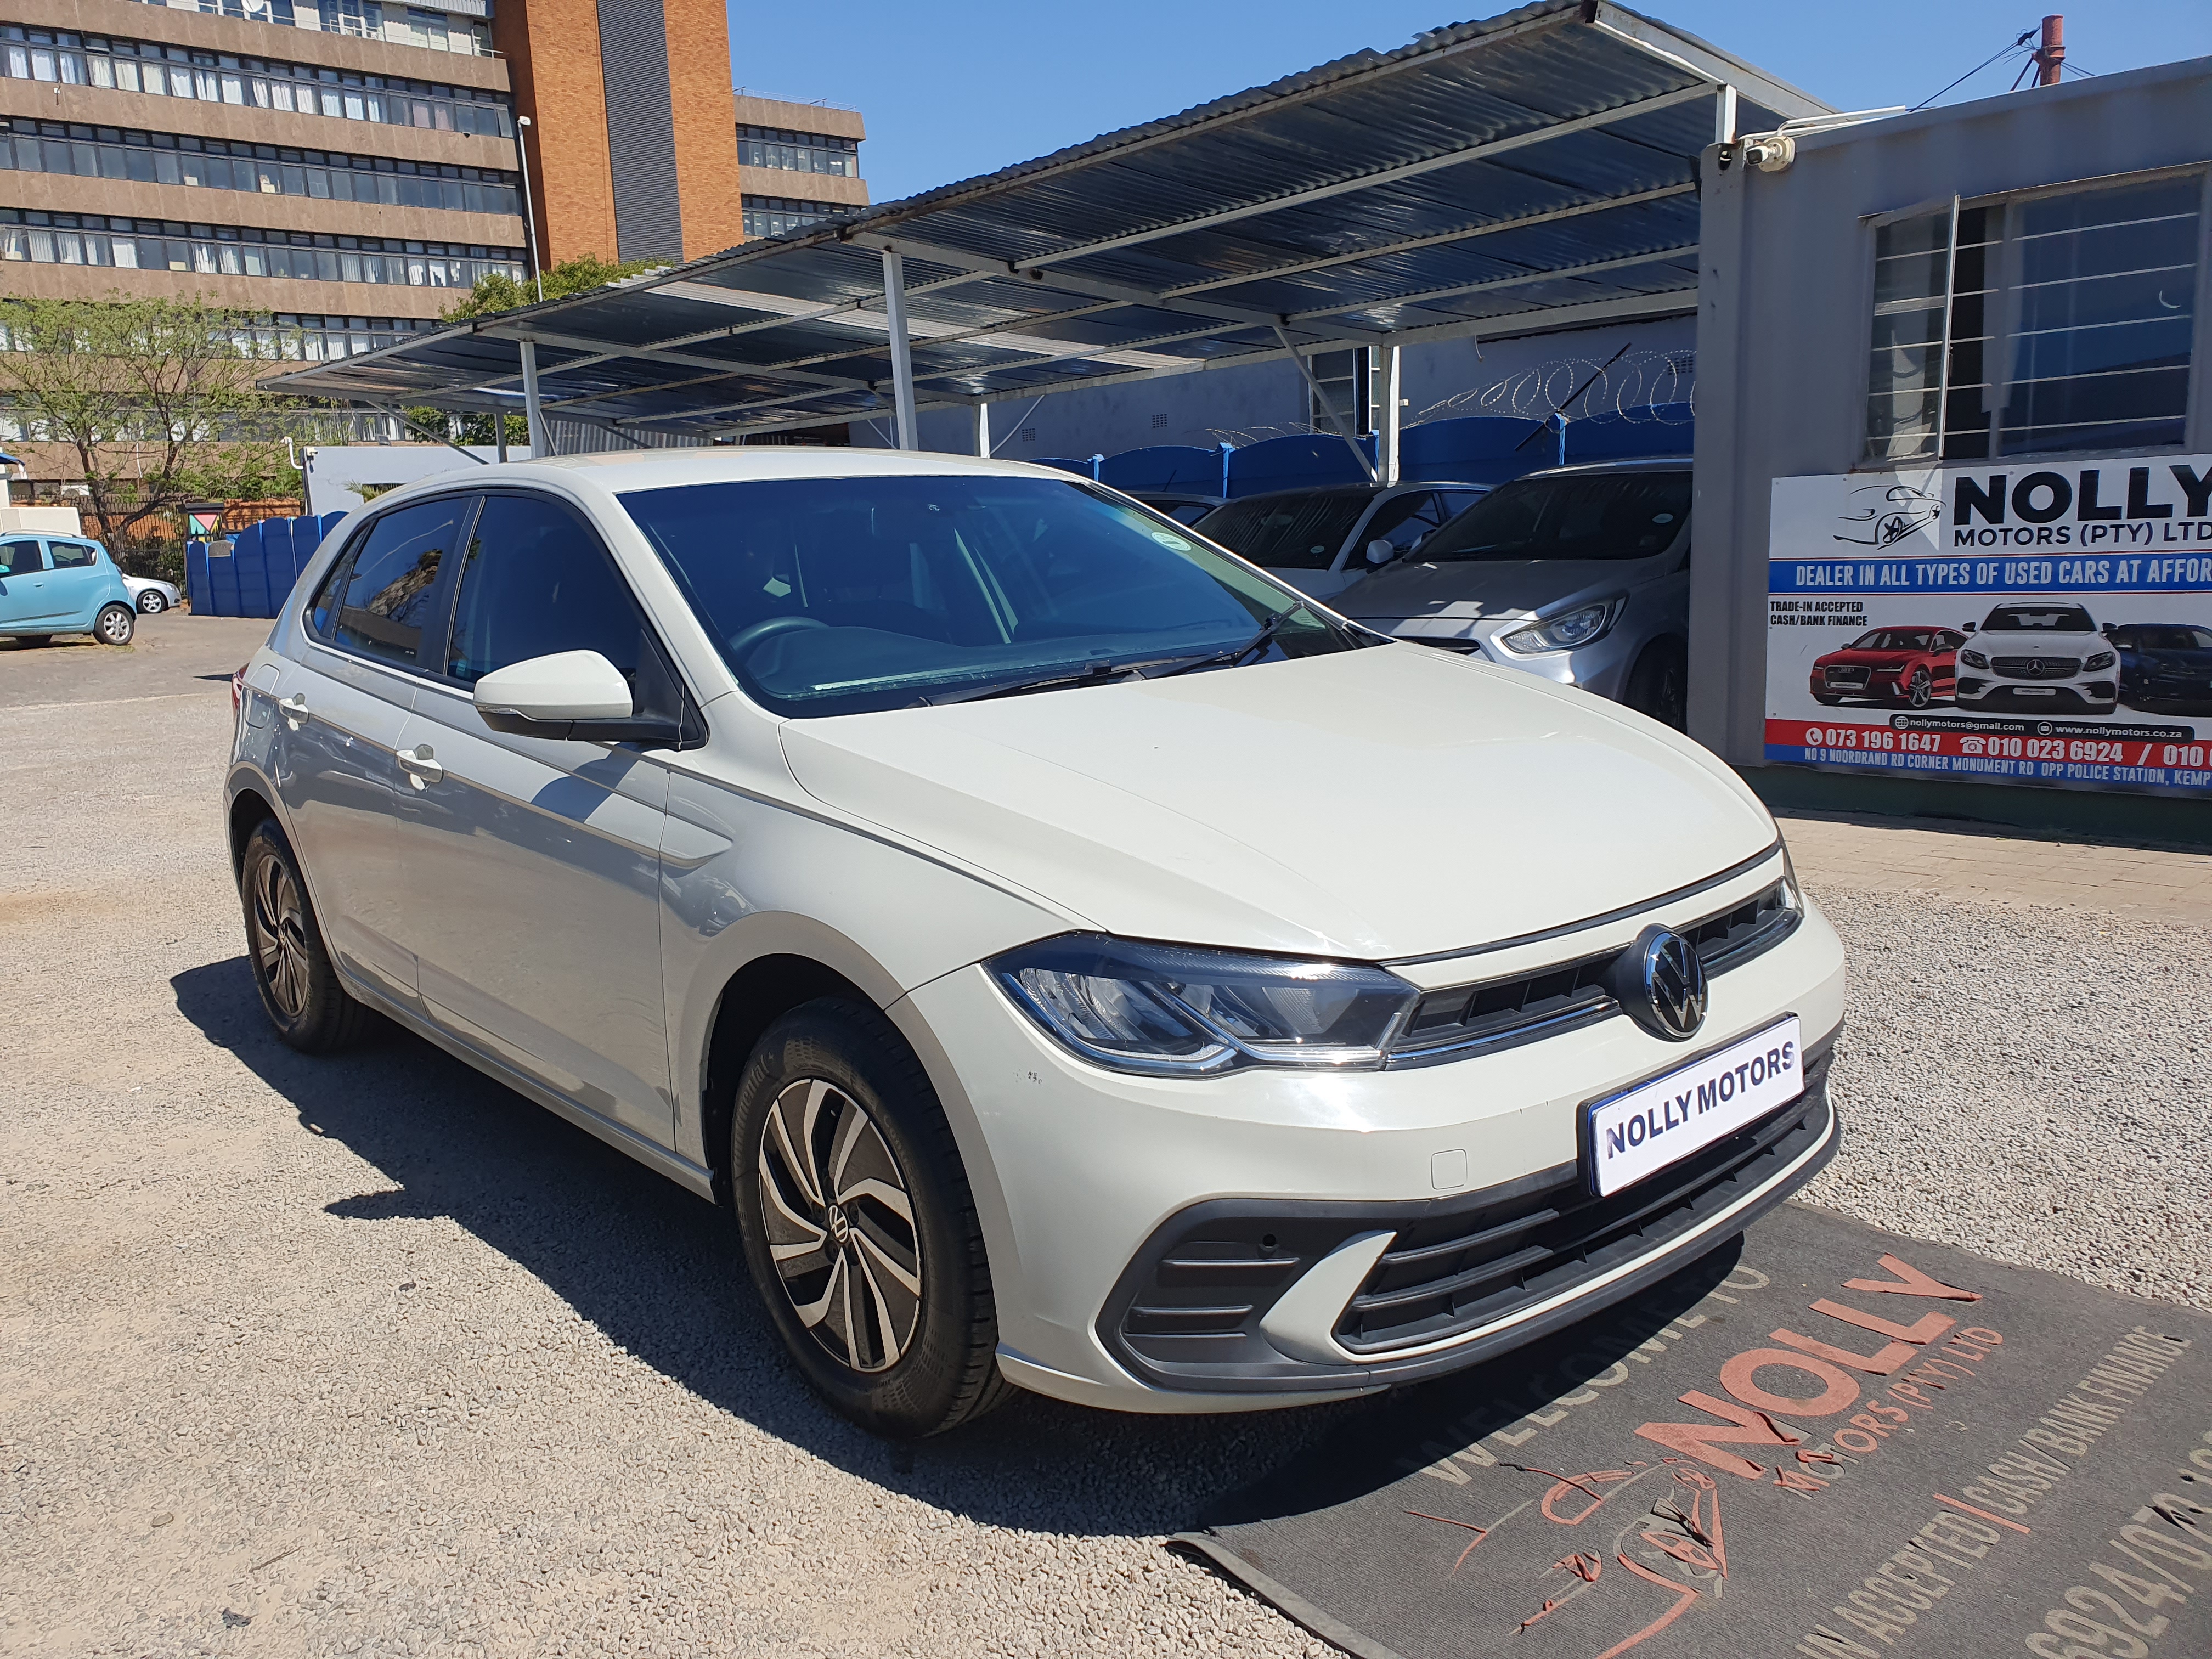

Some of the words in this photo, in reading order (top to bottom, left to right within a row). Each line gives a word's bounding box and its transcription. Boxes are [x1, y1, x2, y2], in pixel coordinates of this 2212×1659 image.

[1953, 464, 2212, 526] NOLLY
[1954, 525, 2071, 547] MOTORS
[2080, 521, 2153, 547] (PTY)
[2163, 521, 2212, 541] LTD
[1796, 565, 1853, 586] DEALER
[1859, 565, 1875, 585] IN
[1880, 564, 1910, 585] ALL
[1915, 562, 1970, 585] TYPES
[1976, 562, 1999, 585] OF
[2004, 561, 2052, 584] USED
[2058, 560, 2110, 584] CARS
[2115, 559, 2141, 583] AT
[1770, 601, 1812, 612] TRADE-IN
[1814, 601, 1863, 612] ACCEPTED
[1770, 614, 1826, 626] CASH/BANK
[1827, 615, 1867, 626] FINANCE
[1826, 728, 1857, 747] 073
[1861, 731, 1893, 749] 196
[1898, 733, 1941, 752] 1647
[1910, 718, 2024, 732] nollymotors@gmail.com
[2055, 726, 2182, 738] www.nollymotors.co.za
[1804, 748, 1818, 760] NO
[1820, 748, 1826, 761] 9
[1830, 749, 1888, 766] NOORDRAND
[1891, 753, 1904, 767] RD
[1908, 754, 1948, 770] CORNER
[1952, 757, 2016, 774] MONUMENT
[2018, 760, 2034, 775] RD
[2041, 762, 2063, 777] OPP
[2067, 763, 2109, 780] POLICE
[2113, 766, 2170, 786] STATION,
[1988, 736, 2022, 757] 010
[2026, 738, 2065, 759] 023
[2069, 742, 2123, 762] 6924
[2163, 744, 2204, 767] 010
[1606, 1088, 1692, 1159] NOLLY
[1697, 1041, 1795, 1115] MOTORS
[1397, 1299, 1708, 1486] WELCOME
[1673, 1263, 1771, 1305] TO
[1633, 1251, 1983, 1480] NOLLY
[1886, 1358, 1976, 1410] (PTY)
[1941, 1327, 2004, 1361] LTD
[1832, 1510, 2001, 1645] ACCEPTED
[1962, 1390, 2126, 1514] CASH/BANK
[2076, 1325, 2193, 1404] FINANCE
